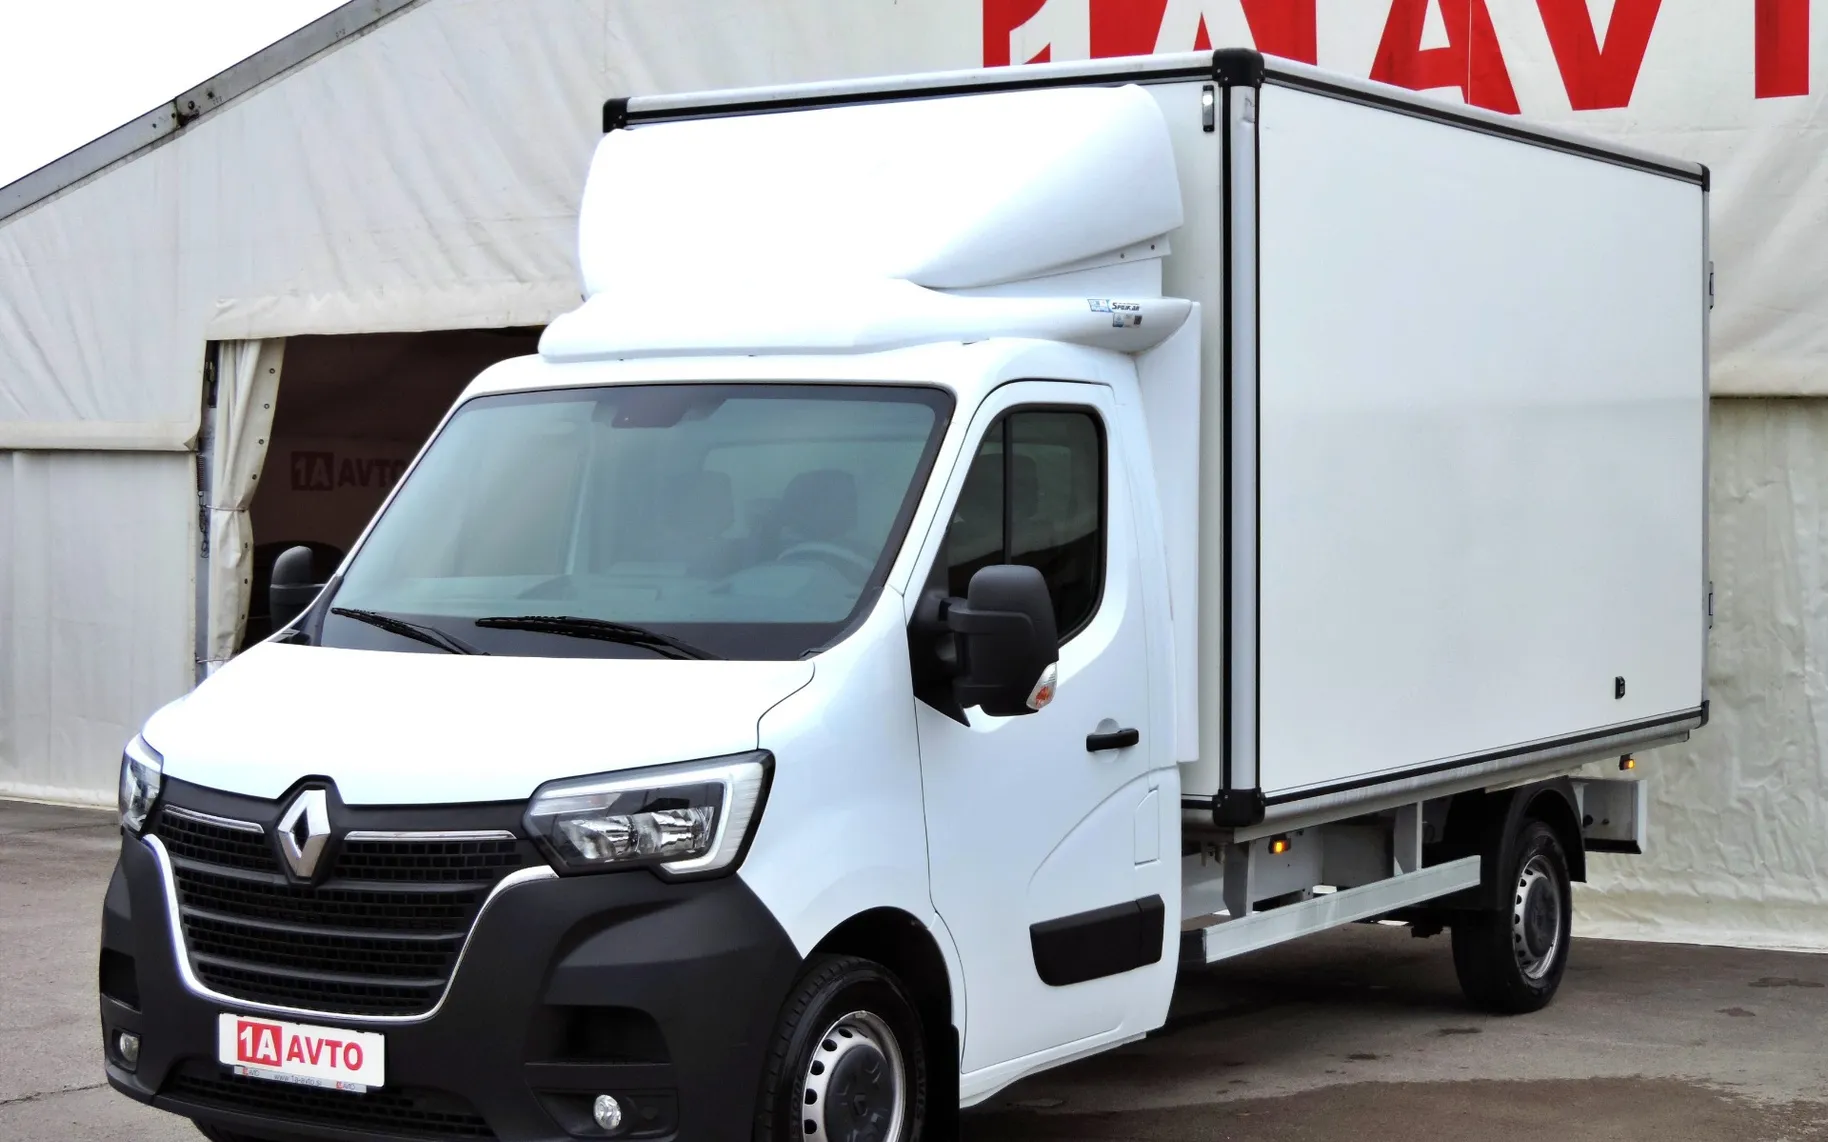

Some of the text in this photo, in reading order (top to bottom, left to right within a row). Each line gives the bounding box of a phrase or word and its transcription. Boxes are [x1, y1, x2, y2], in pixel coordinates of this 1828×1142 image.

[293, 454, 332, 488] 1A
[239, 1024, 363, 1071] 1A AVTO
